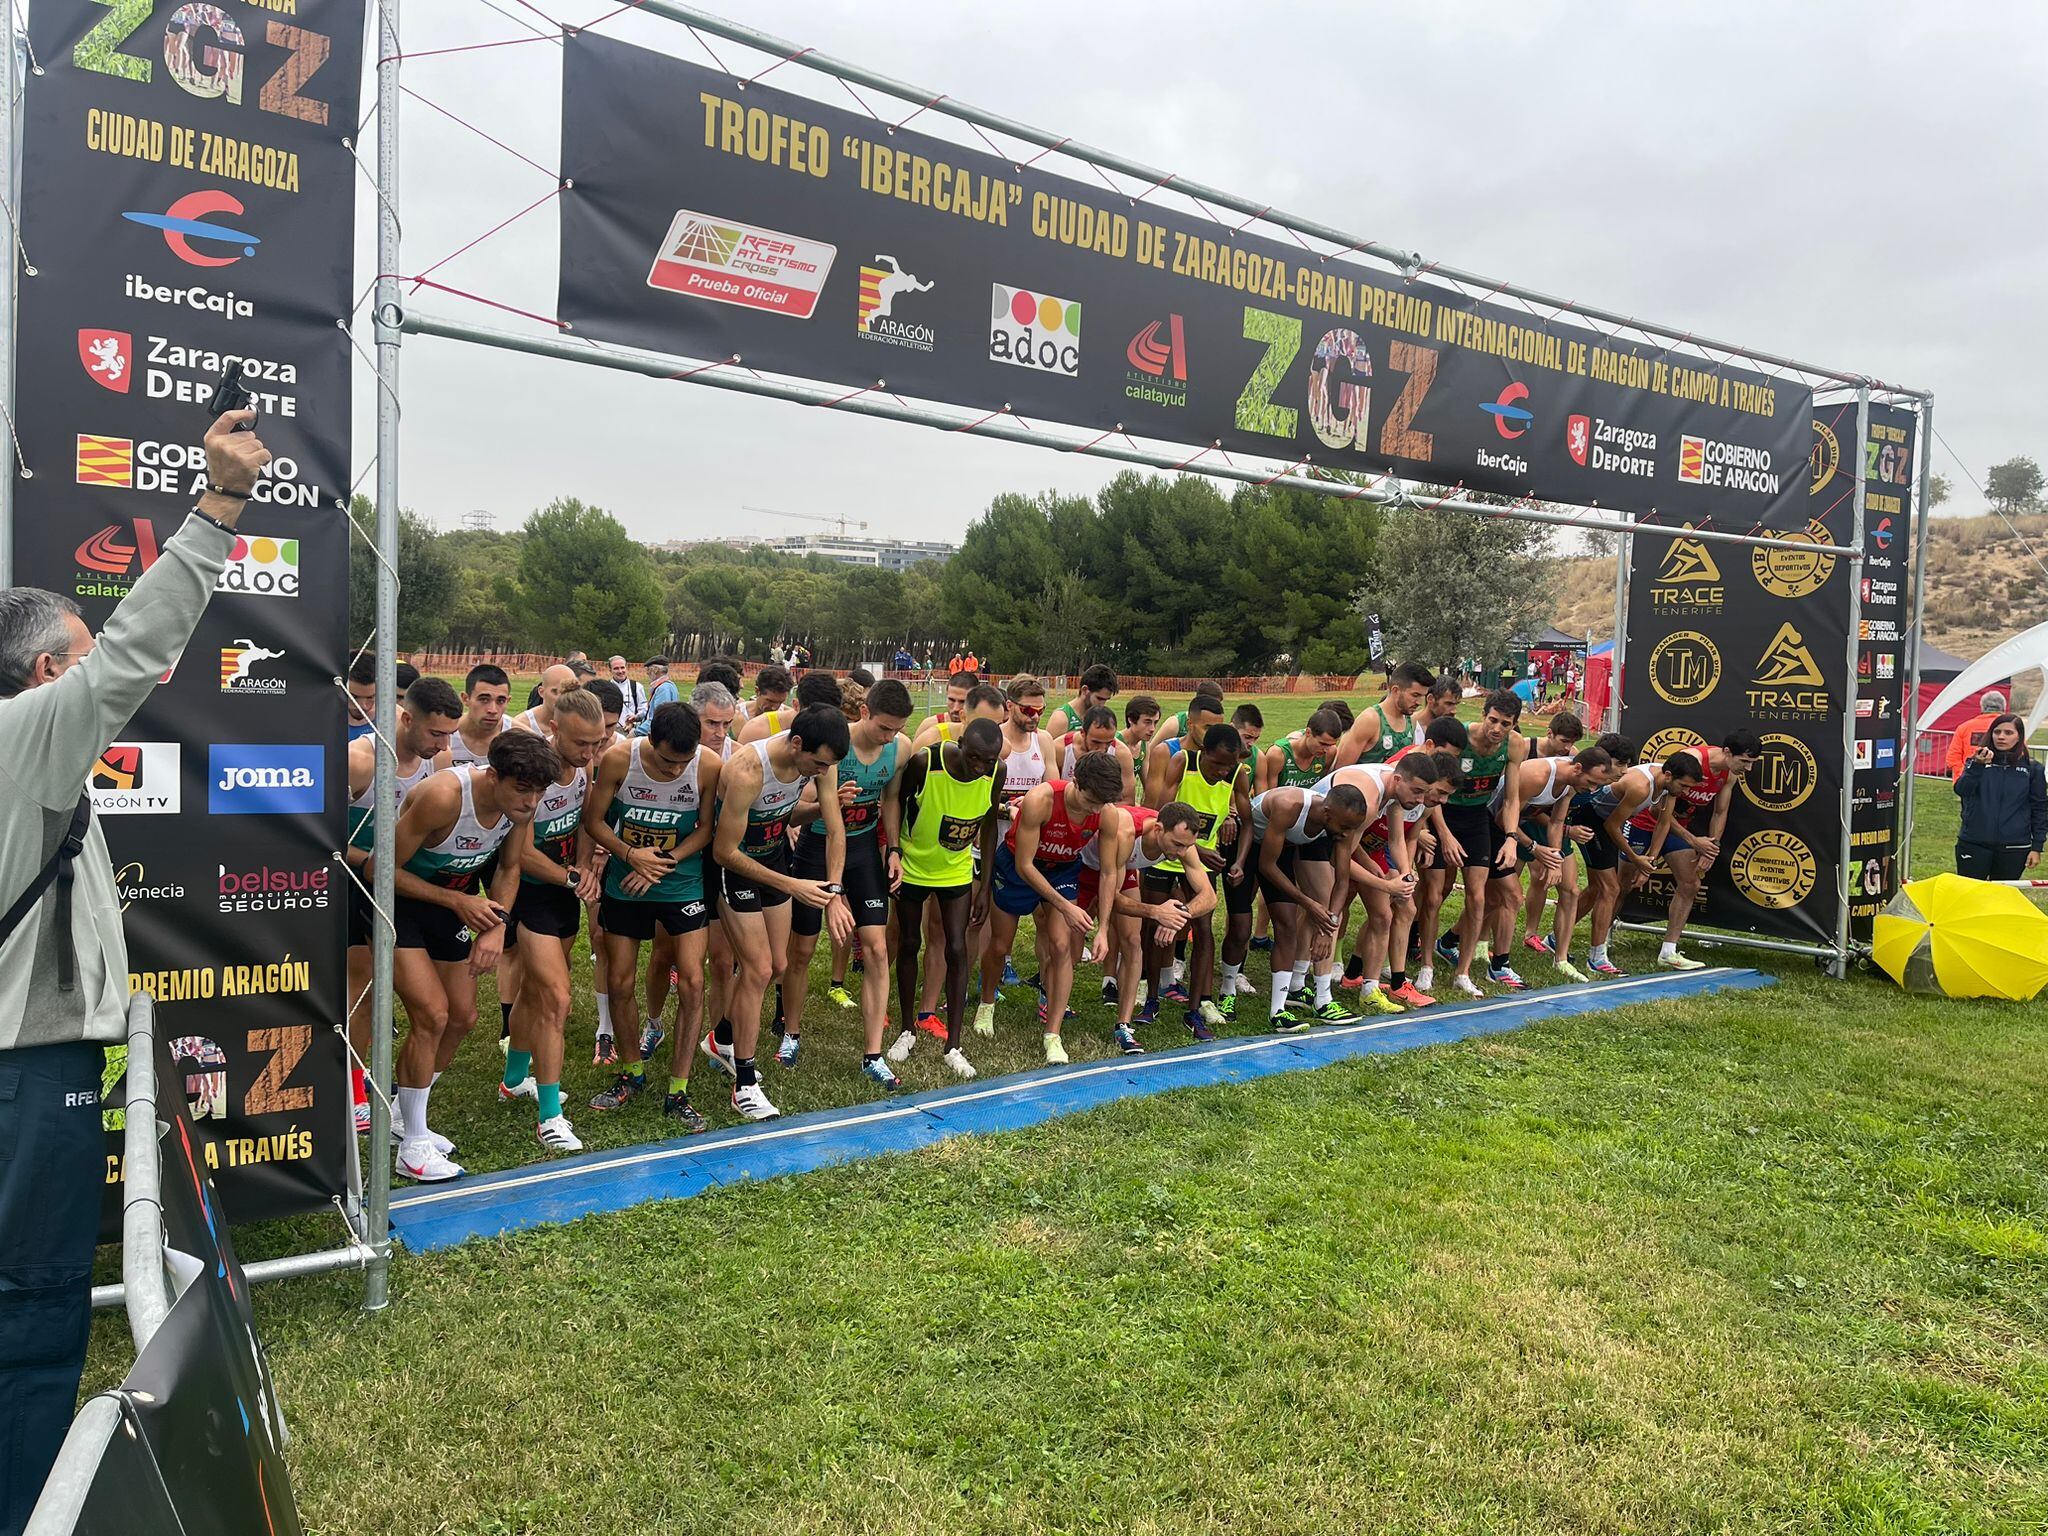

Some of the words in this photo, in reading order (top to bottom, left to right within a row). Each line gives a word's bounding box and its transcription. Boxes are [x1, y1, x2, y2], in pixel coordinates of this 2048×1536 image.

[72, 0, 331, 127] ZGZ
[86, 108, 164, 163] CIUDAD
[170, 126, 195, 170] DE
[200, 132, 300, 193] ZARAGOZA
[700, 91, 830, 179] TROFEO
[1031, 191, 1129, 259] CIUDAD
[1136, 220, 1166, 270] DE
[1360, 283, 1430, 338] PREMIO
[1436, 304, 1564, 371] INTERNACIONAL
[1567, 340, 1587, 377] DE
[1590, 347, 1649, 391] ARAGÓN
[1653, 362, 1668, 393] DE
[1671, 366, 1718, 407] CAMPO
[1720, 381, 1731, 407] A
[1733, 378, 1776, 419] TRAVÉS
[741, 234, 796, 257] RFEA
[731, 259, 780, 277] CROSS
[736, 248, 818, 274] ATLETISMO
[125, 274, 254, 320] iberCaja
[687, 273, 741, 295] Prueba
[743, 285, 789, 305] Oficial
[857, 331, 899, 346] FEDERACIÓN
[899, 340, 934, 353] ATLETISMO
[879, 319, 934, 343] ARAGÓN
[990, 326, 1080, 374] adoc
[1126, 371, 1187, 389] ATLETISMO
[1234, 305, 1439, 462] ZGZ
[146, 369, 296, 417] DEPTE
[1125, 384, 1186, 408] calatayud
[1594, 417, 1657, 453] Zaragoza
[137, 441, 298, 480] GOBNO
[1476, 448, 1528, 474] iberCaja
[1592, 446, 1655, 478] DEPORTE
[1704, 440, 1772, 472] GOBIERNO
[1866, 441, 1908, 485] ZGZ
[137, 467, 179, 494] DE
[189, 473, 320, 508] AGON
[1702, 463, 1723, 487] DE
[1724, 466, 1779, 494] ARAGON
[1868, 555, 1891, 568] iberCaja
[215, 562, 299, 594] doc
[1871, 579, 1897, 594] Zaragoza
[1650, 587, 1725, 604] TRACE
[1870, 592, 1897, 605] DEPORTE
[1653, 606, 1723, 616] TENERIFE
[1868, 620, 1896, 631] GOBIERNO
[1654, 632, 1690, 656] MANAGER
[1699, 636, 1718, 656] PILAR
[1665, 648, 1707, 689] TM
[239, 677, 287, 689] ARAGÓN
[1667, 695, 1699, 704] CALATAYUD
[1745, 691, 1829, 709] TRACE
[1749, 710, 1828, 721] TENERIFE
[1640, 730, 1704, 765] BLIACTIV
[1792, 740, 1813, 762] PILAR
[1473, 777, 1490, 790] 13
[1760, 751, 1802, 795] TM
[92, 795, 140, 808] AGÓN
[146, 797, 168, 808] TV
[624, 807, 682, 825] ATLEET
[845, 808, 868, 823] 20
[630, 831, 669, 851] 387
[763, 821, 783, 840] 19
[1752, 874, 1791, 885] DEPORTIVOS
[1760, 865, 1786, 875] EVENTOS
[117, 884, 184, 900] Venecia
[219, 896, 329, 913] SEGUROS
[129, 967, 214, 1001] PREMIO
[222, 953, 310, 996] ARAGÓN
[204, 1142, 220, 1170] A
[225, 1125, 313, 1168] TRAVÉS
